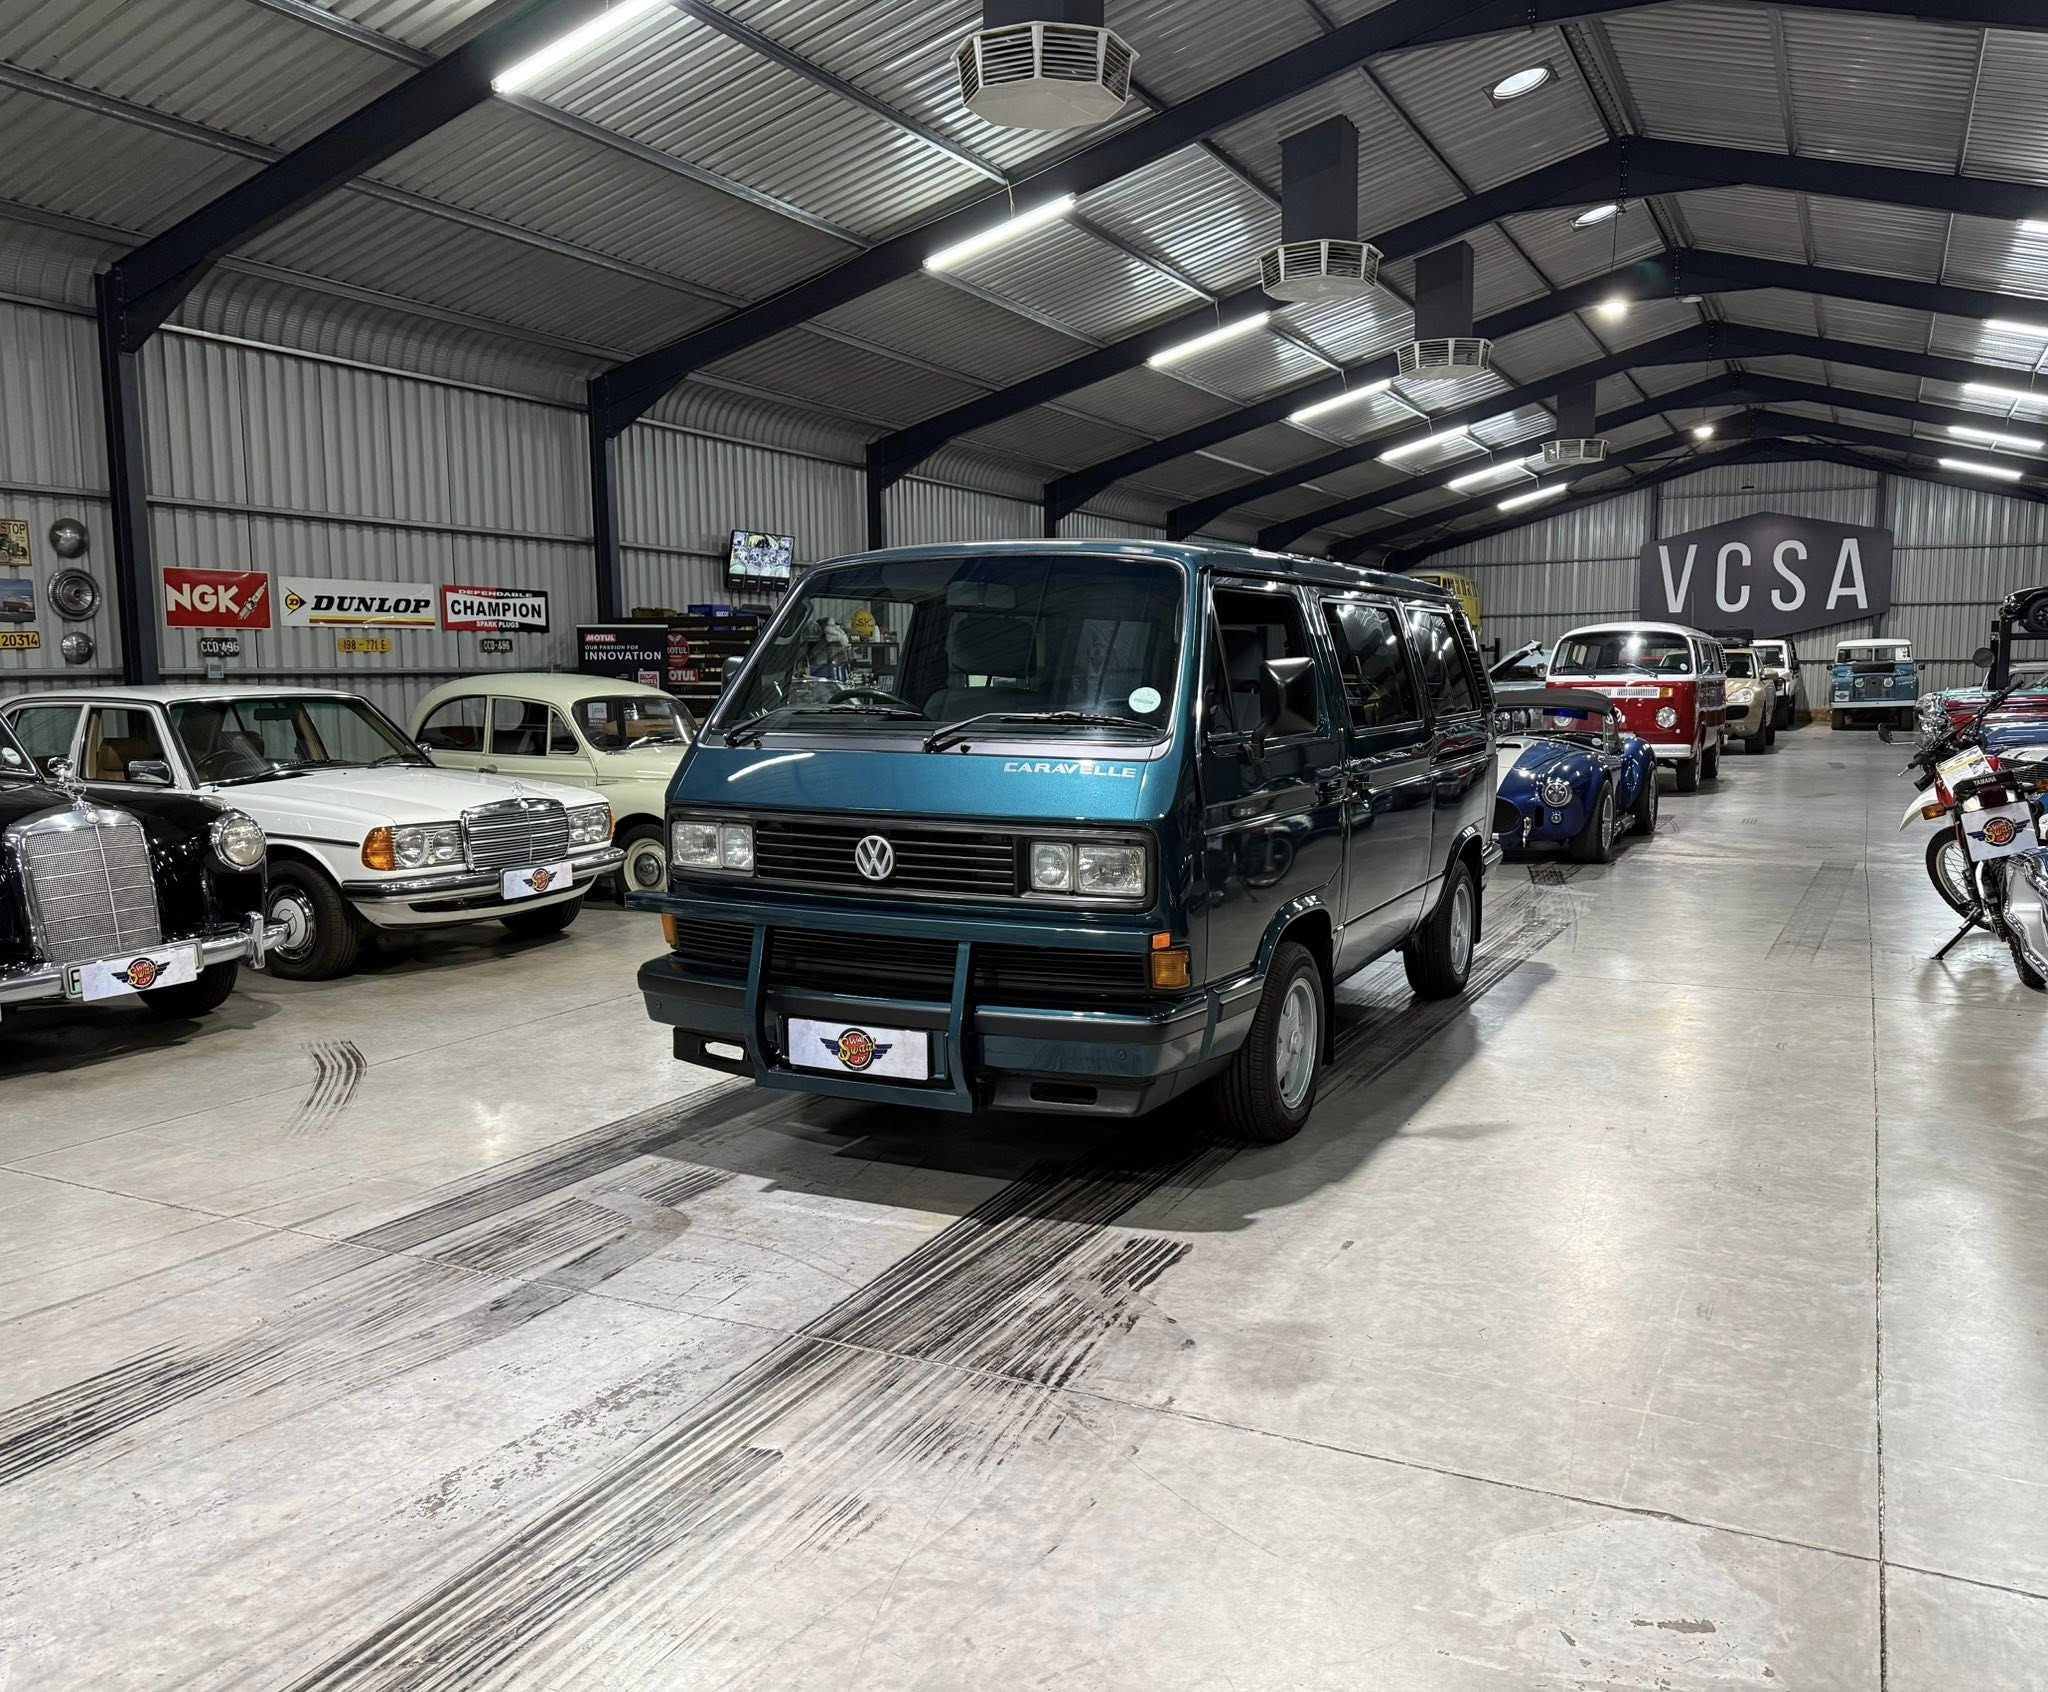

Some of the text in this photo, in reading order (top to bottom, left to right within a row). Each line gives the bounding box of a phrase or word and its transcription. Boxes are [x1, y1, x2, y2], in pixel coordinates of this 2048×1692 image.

[1658, 538, 1868, 613] VCSA
[165, 583, 242, 614] NGK
[458, 589, 533, 598] DEPENDABLE
[311, 595, 431, 614] DUNLOP
[450, 600, 542, 618] CHAMPION
[476, 620, 498, 628] SPARK
[1, 634, 38, 647] 20314
[584, 633, 617, 642] MOTUL
[584, 651, 662, 660] INNOVATION
[668, 670, 696, 681] OTUL
[1003, 762, 1137, 778] CARAVELLE
[1973, 776, 1997, 786] YAMAHA
